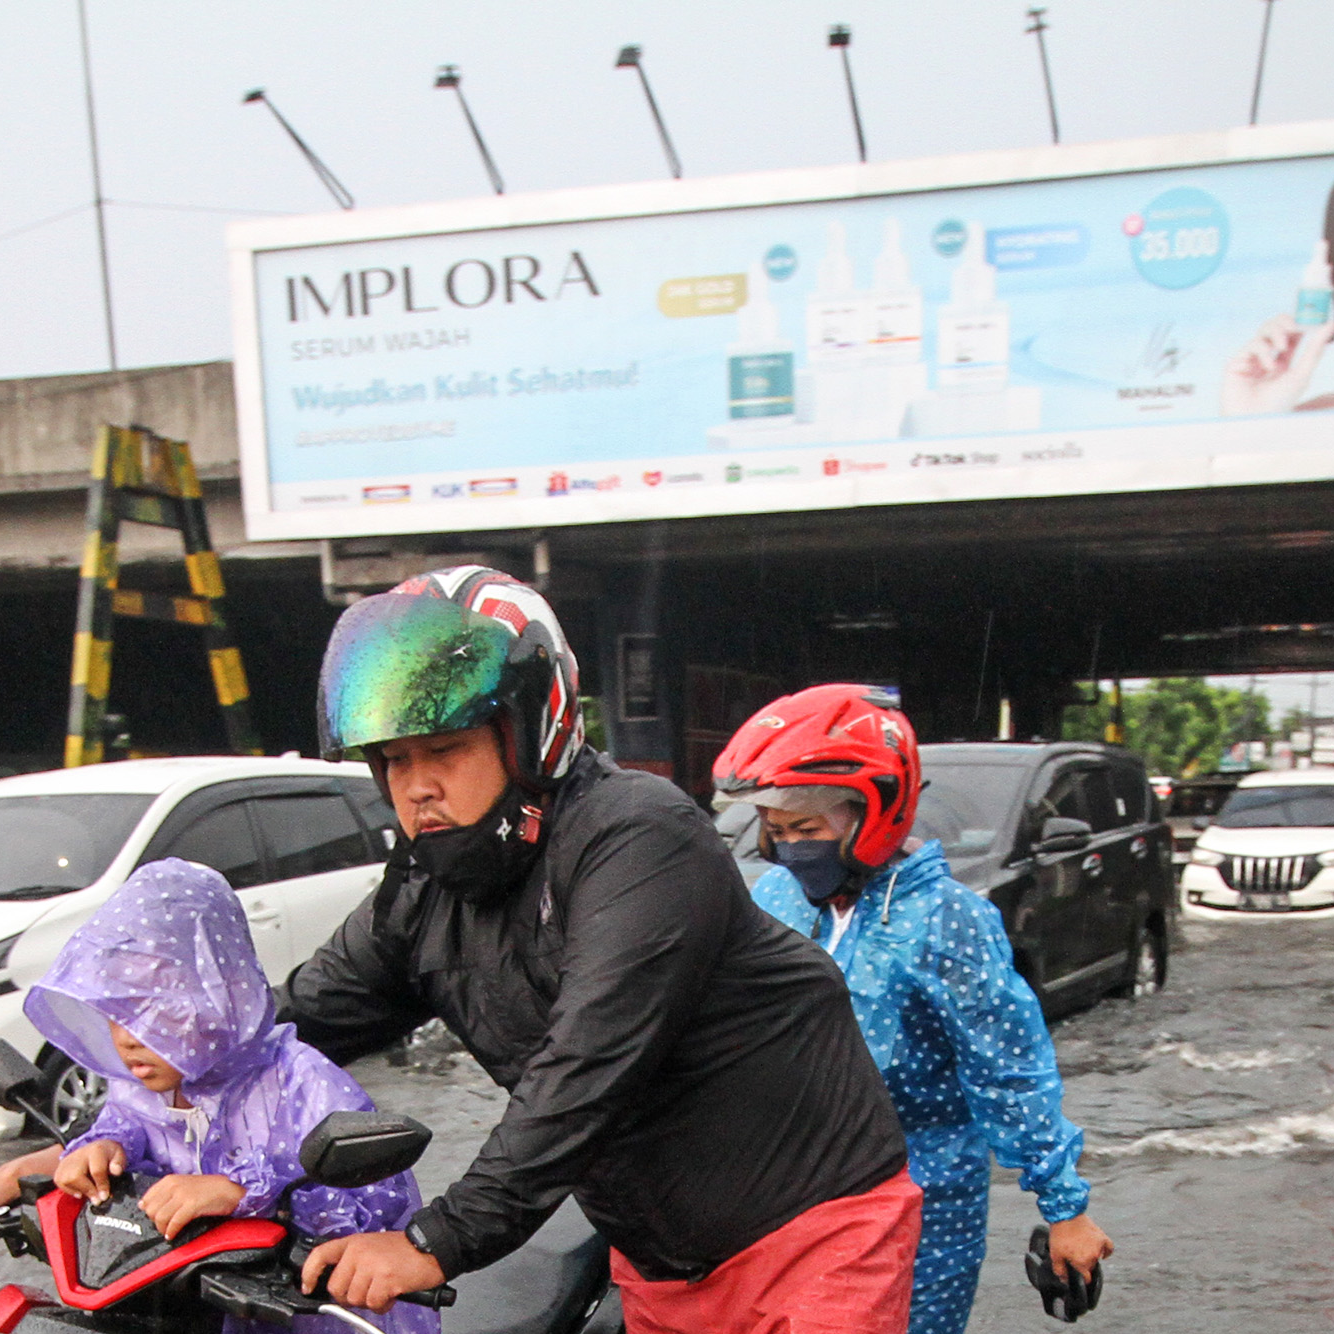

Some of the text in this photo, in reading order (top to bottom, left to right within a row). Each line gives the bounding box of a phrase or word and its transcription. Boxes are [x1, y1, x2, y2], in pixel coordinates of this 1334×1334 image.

[285, 250, 603, 323] IMPLORA
[290, 328, 472, 361] SERUM WAJAH
[94, 1215, 142, 1235] HONDA
